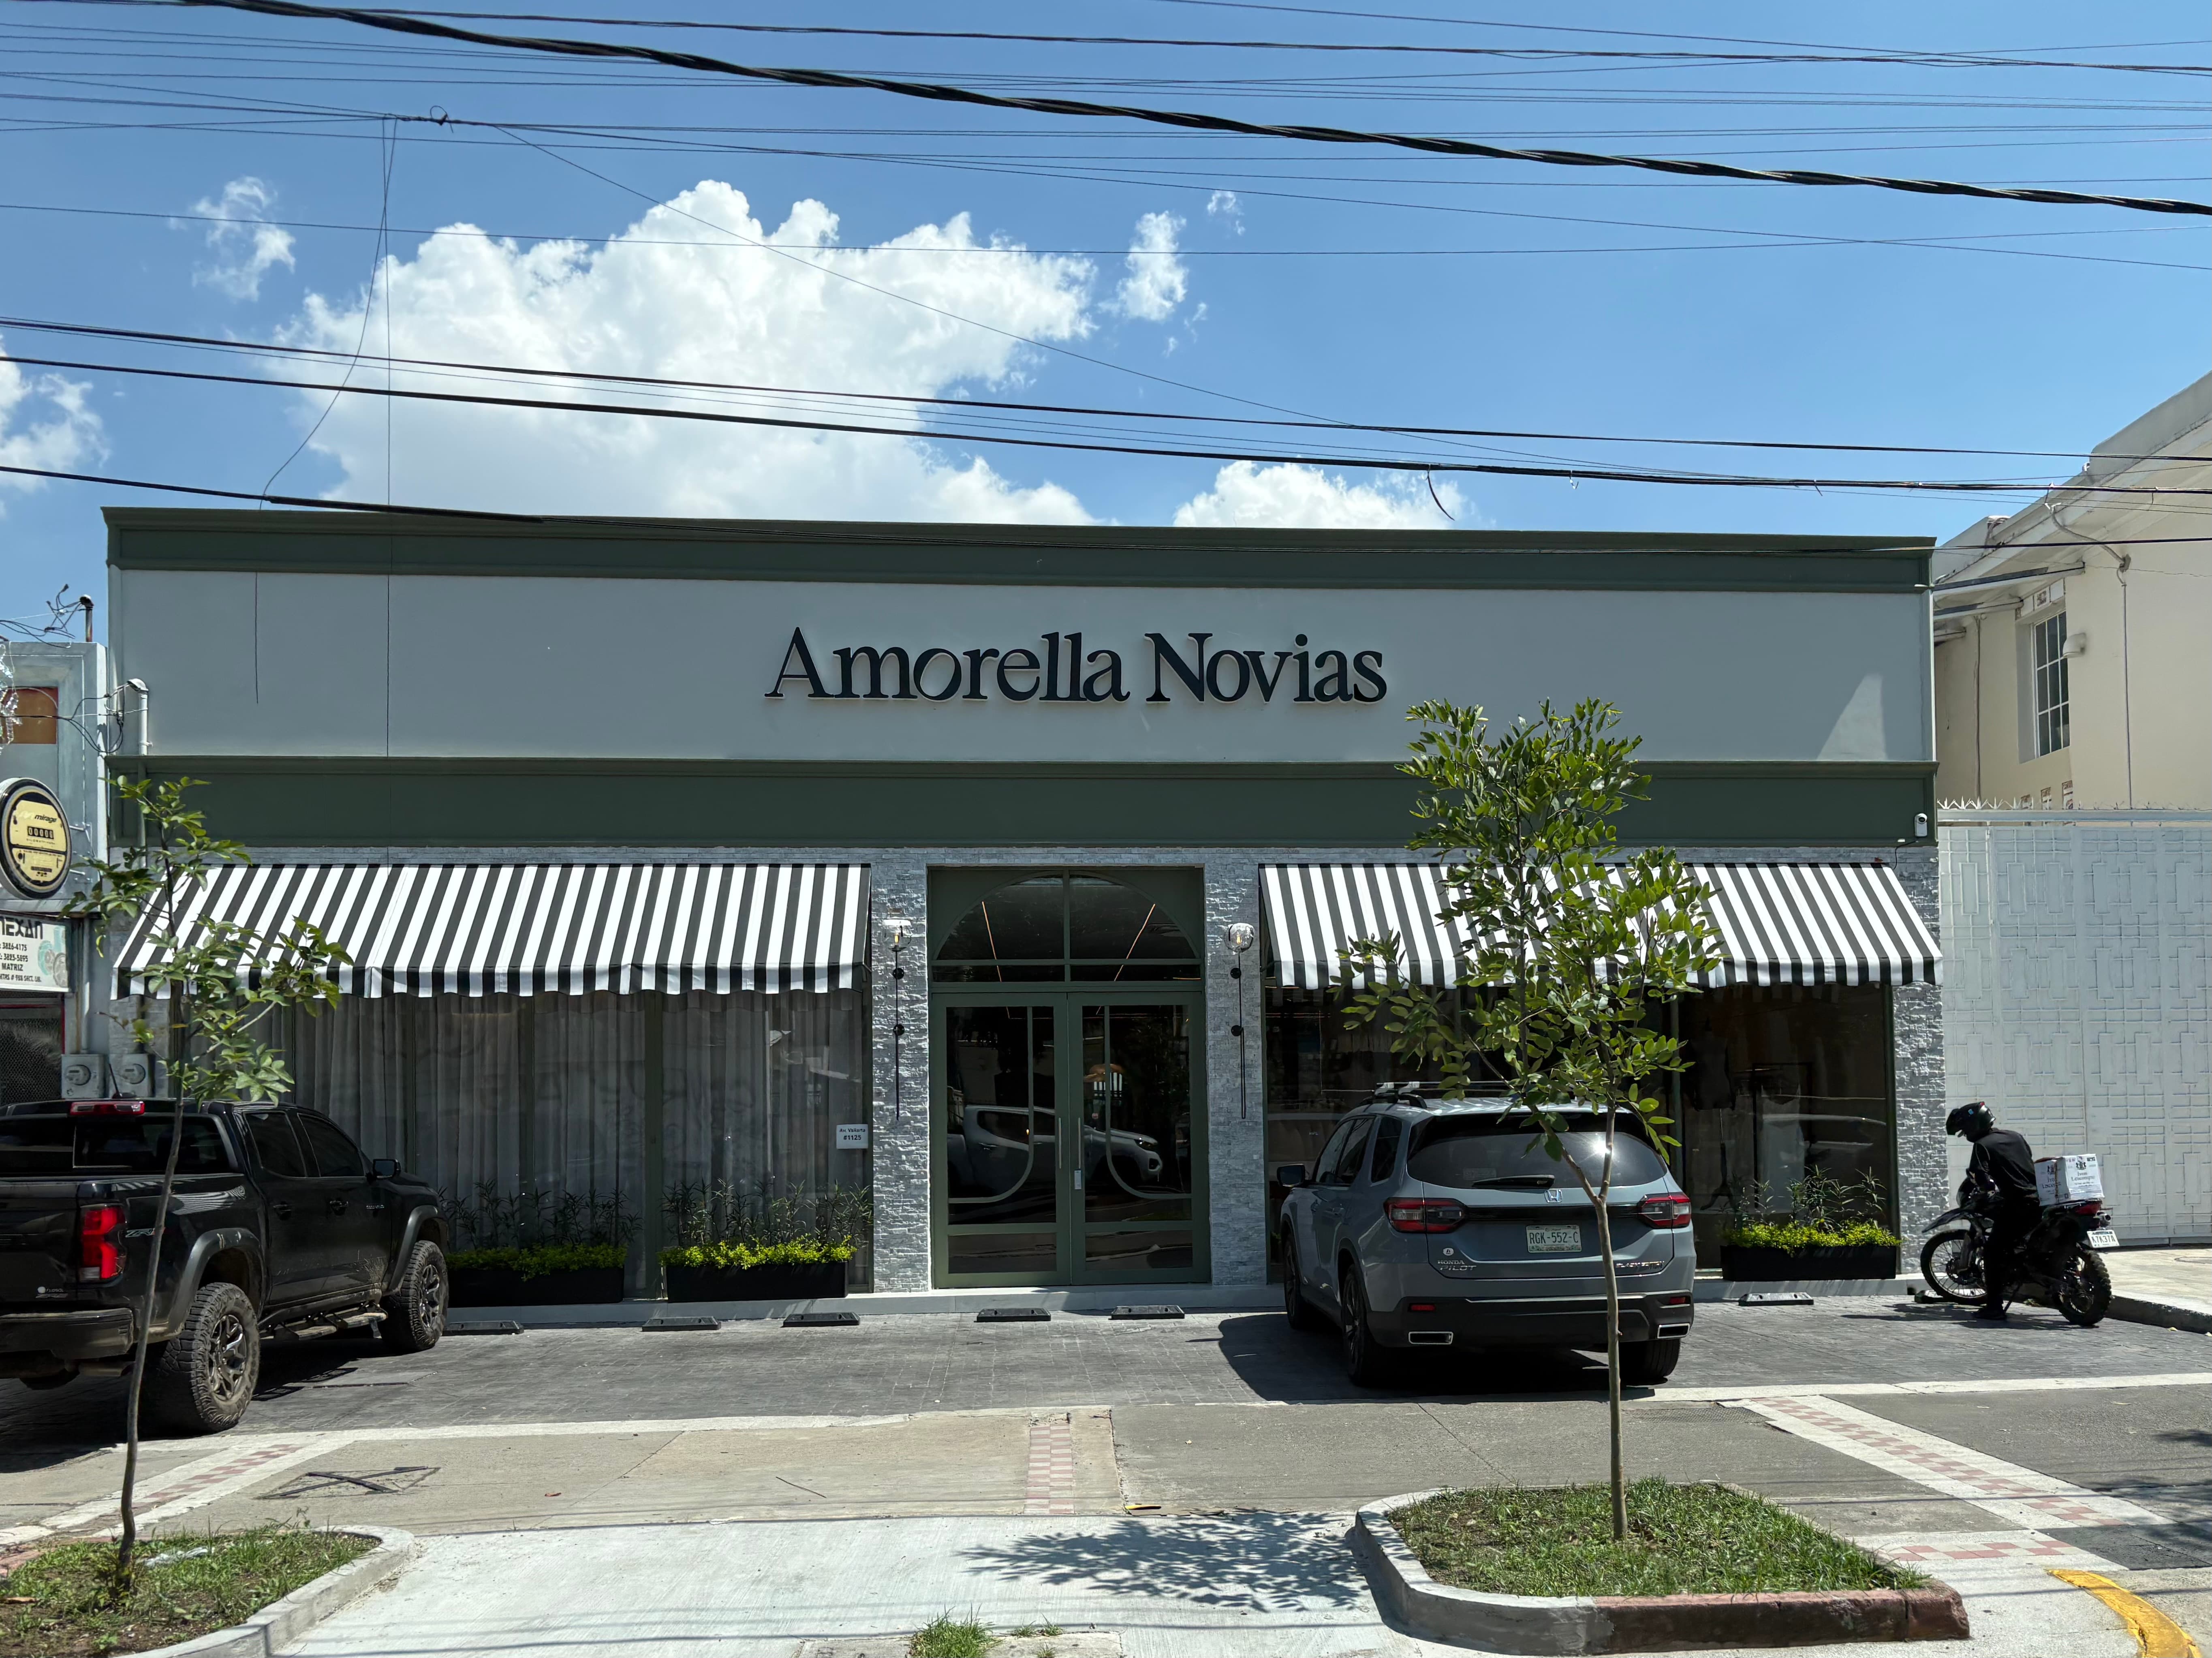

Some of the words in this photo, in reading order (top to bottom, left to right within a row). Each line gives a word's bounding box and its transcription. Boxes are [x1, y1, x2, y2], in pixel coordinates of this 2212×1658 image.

[764, 626, 1131, 702] Amorella
[1144, 632, 1387, 703] Novias
[34, 815, 57, 823] mirage
[2, 963, 23, 971] MATRIZ
[1529, 1232, 1579, 1244] RGK-552-C
